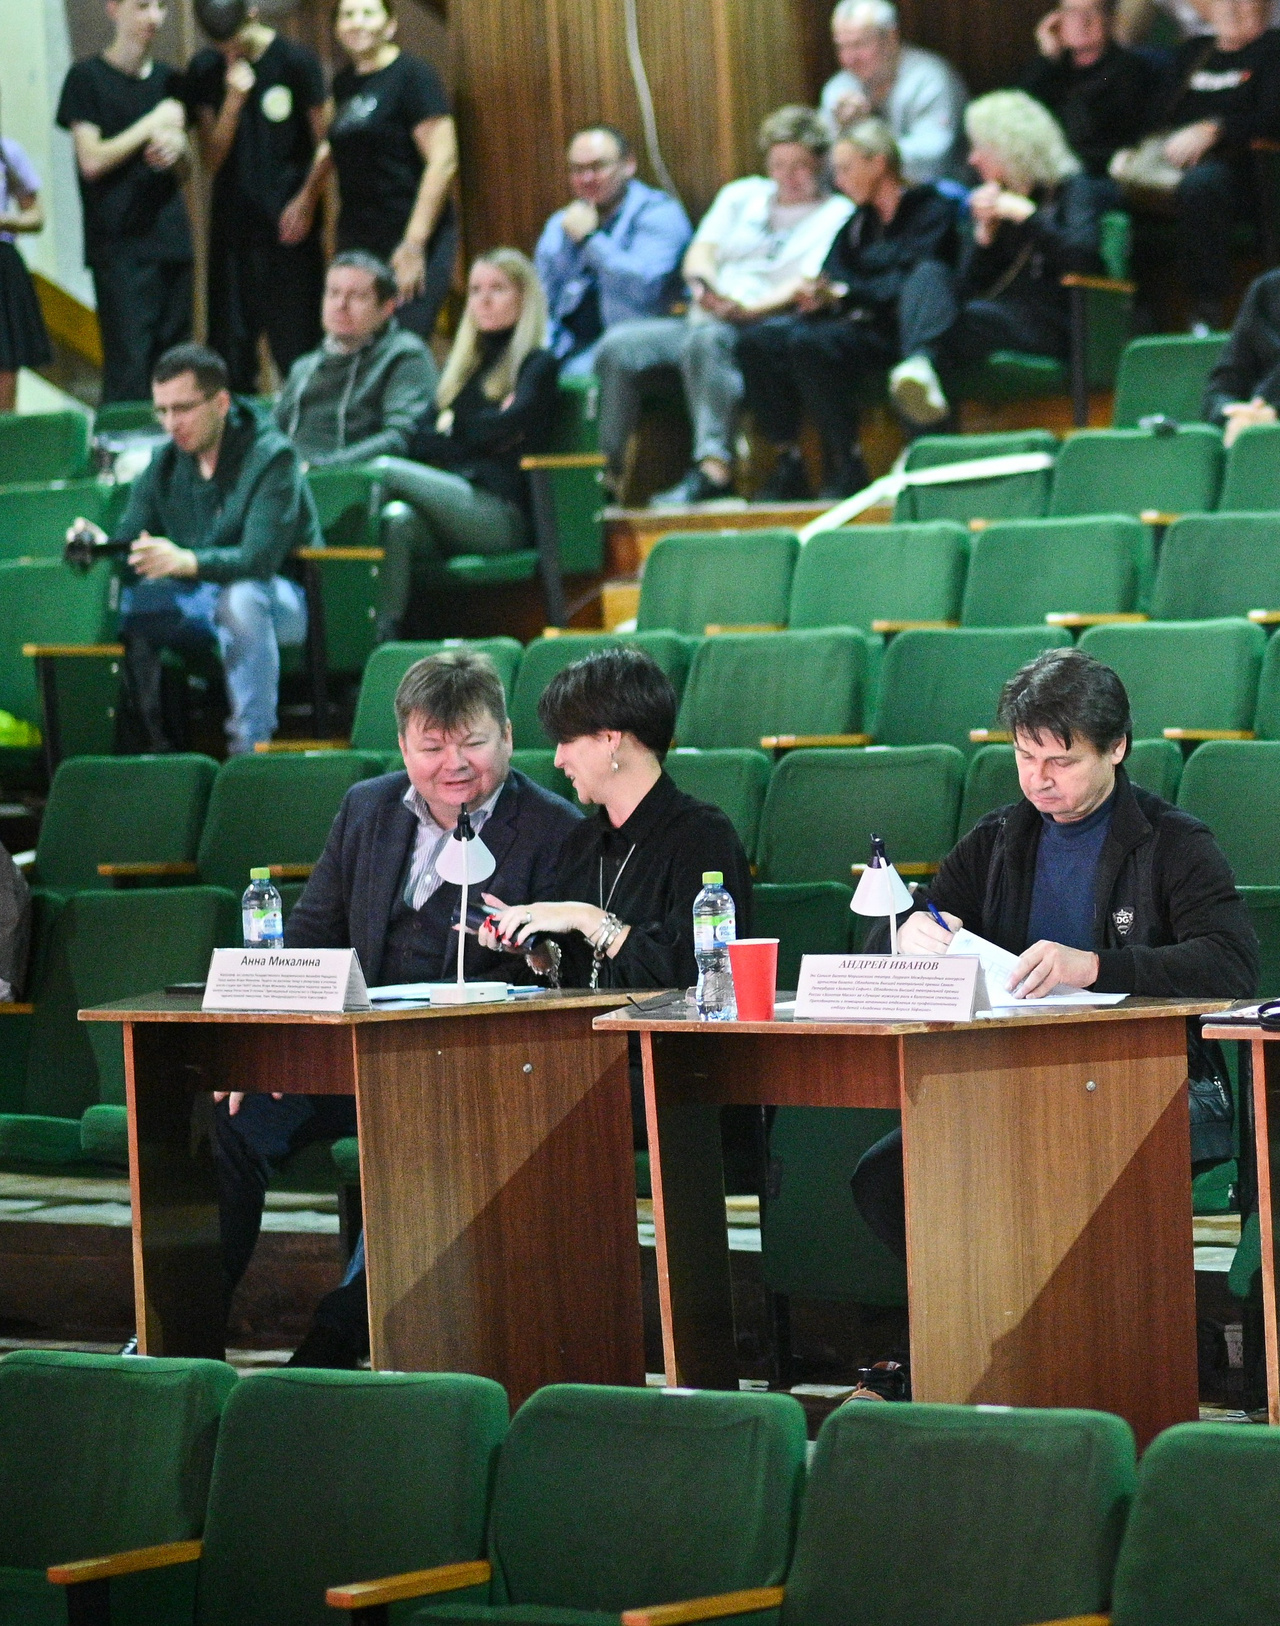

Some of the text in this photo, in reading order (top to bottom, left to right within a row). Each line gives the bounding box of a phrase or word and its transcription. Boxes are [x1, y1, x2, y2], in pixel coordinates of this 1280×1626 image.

[1116, 916, 1129, 924] DG
[241, 955, 321, 967] Анна Михалина
[839, 958, 939, 970] АНДРЕЙ ИВАНОВ
